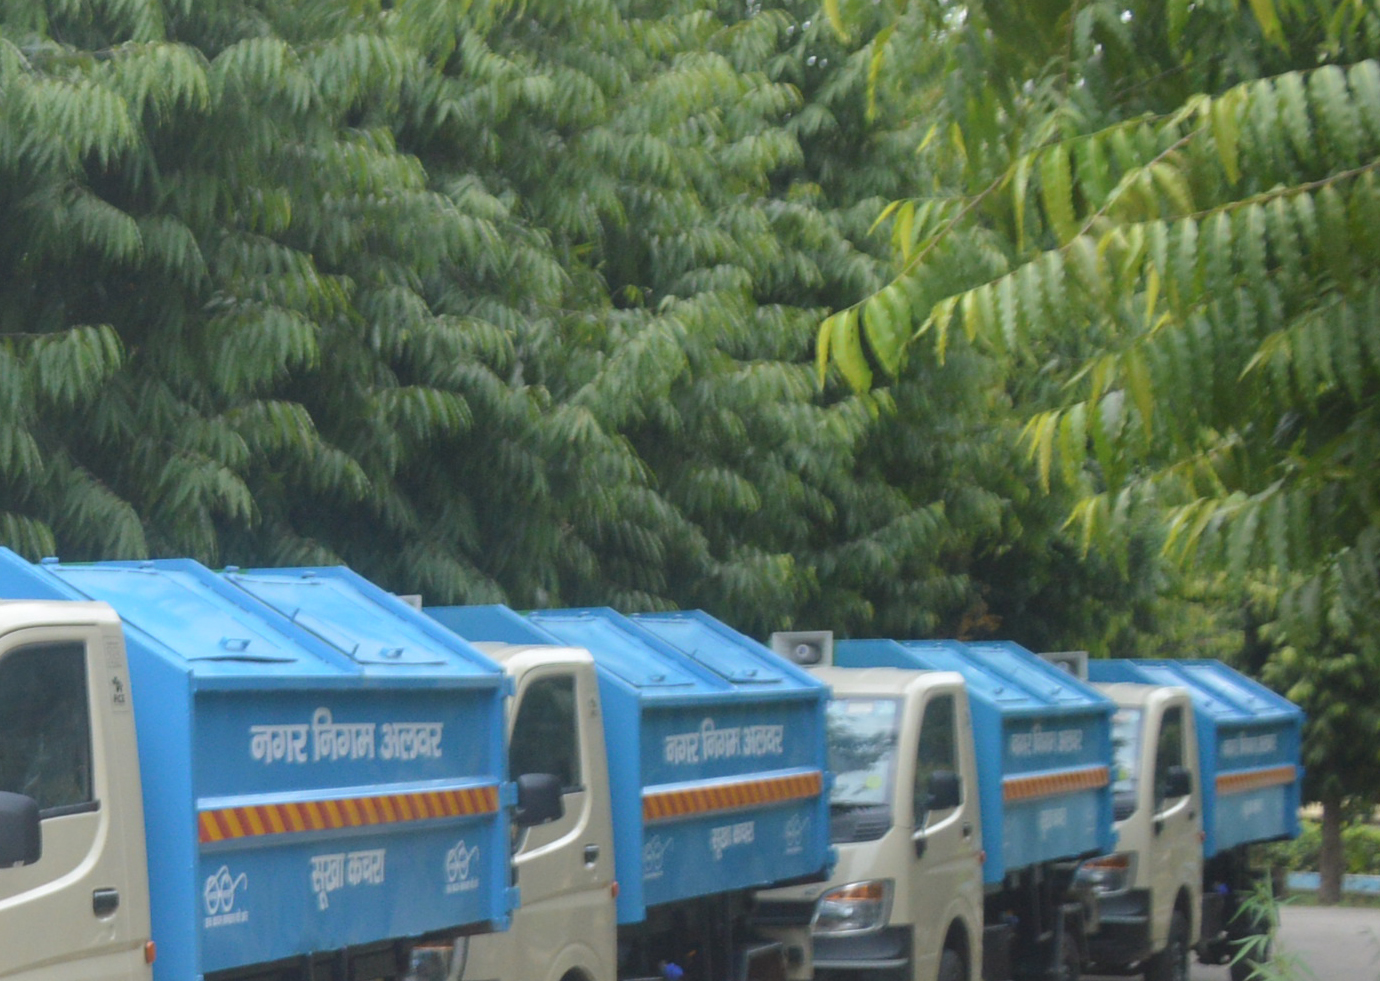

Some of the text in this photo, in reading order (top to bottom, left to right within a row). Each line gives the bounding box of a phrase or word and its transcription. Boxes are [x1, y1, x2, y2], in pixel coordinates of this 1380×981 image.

[250, 707, 443, 764] नगर निगम अलवर
[310, 849, 386, 910] सूखा कचरा
